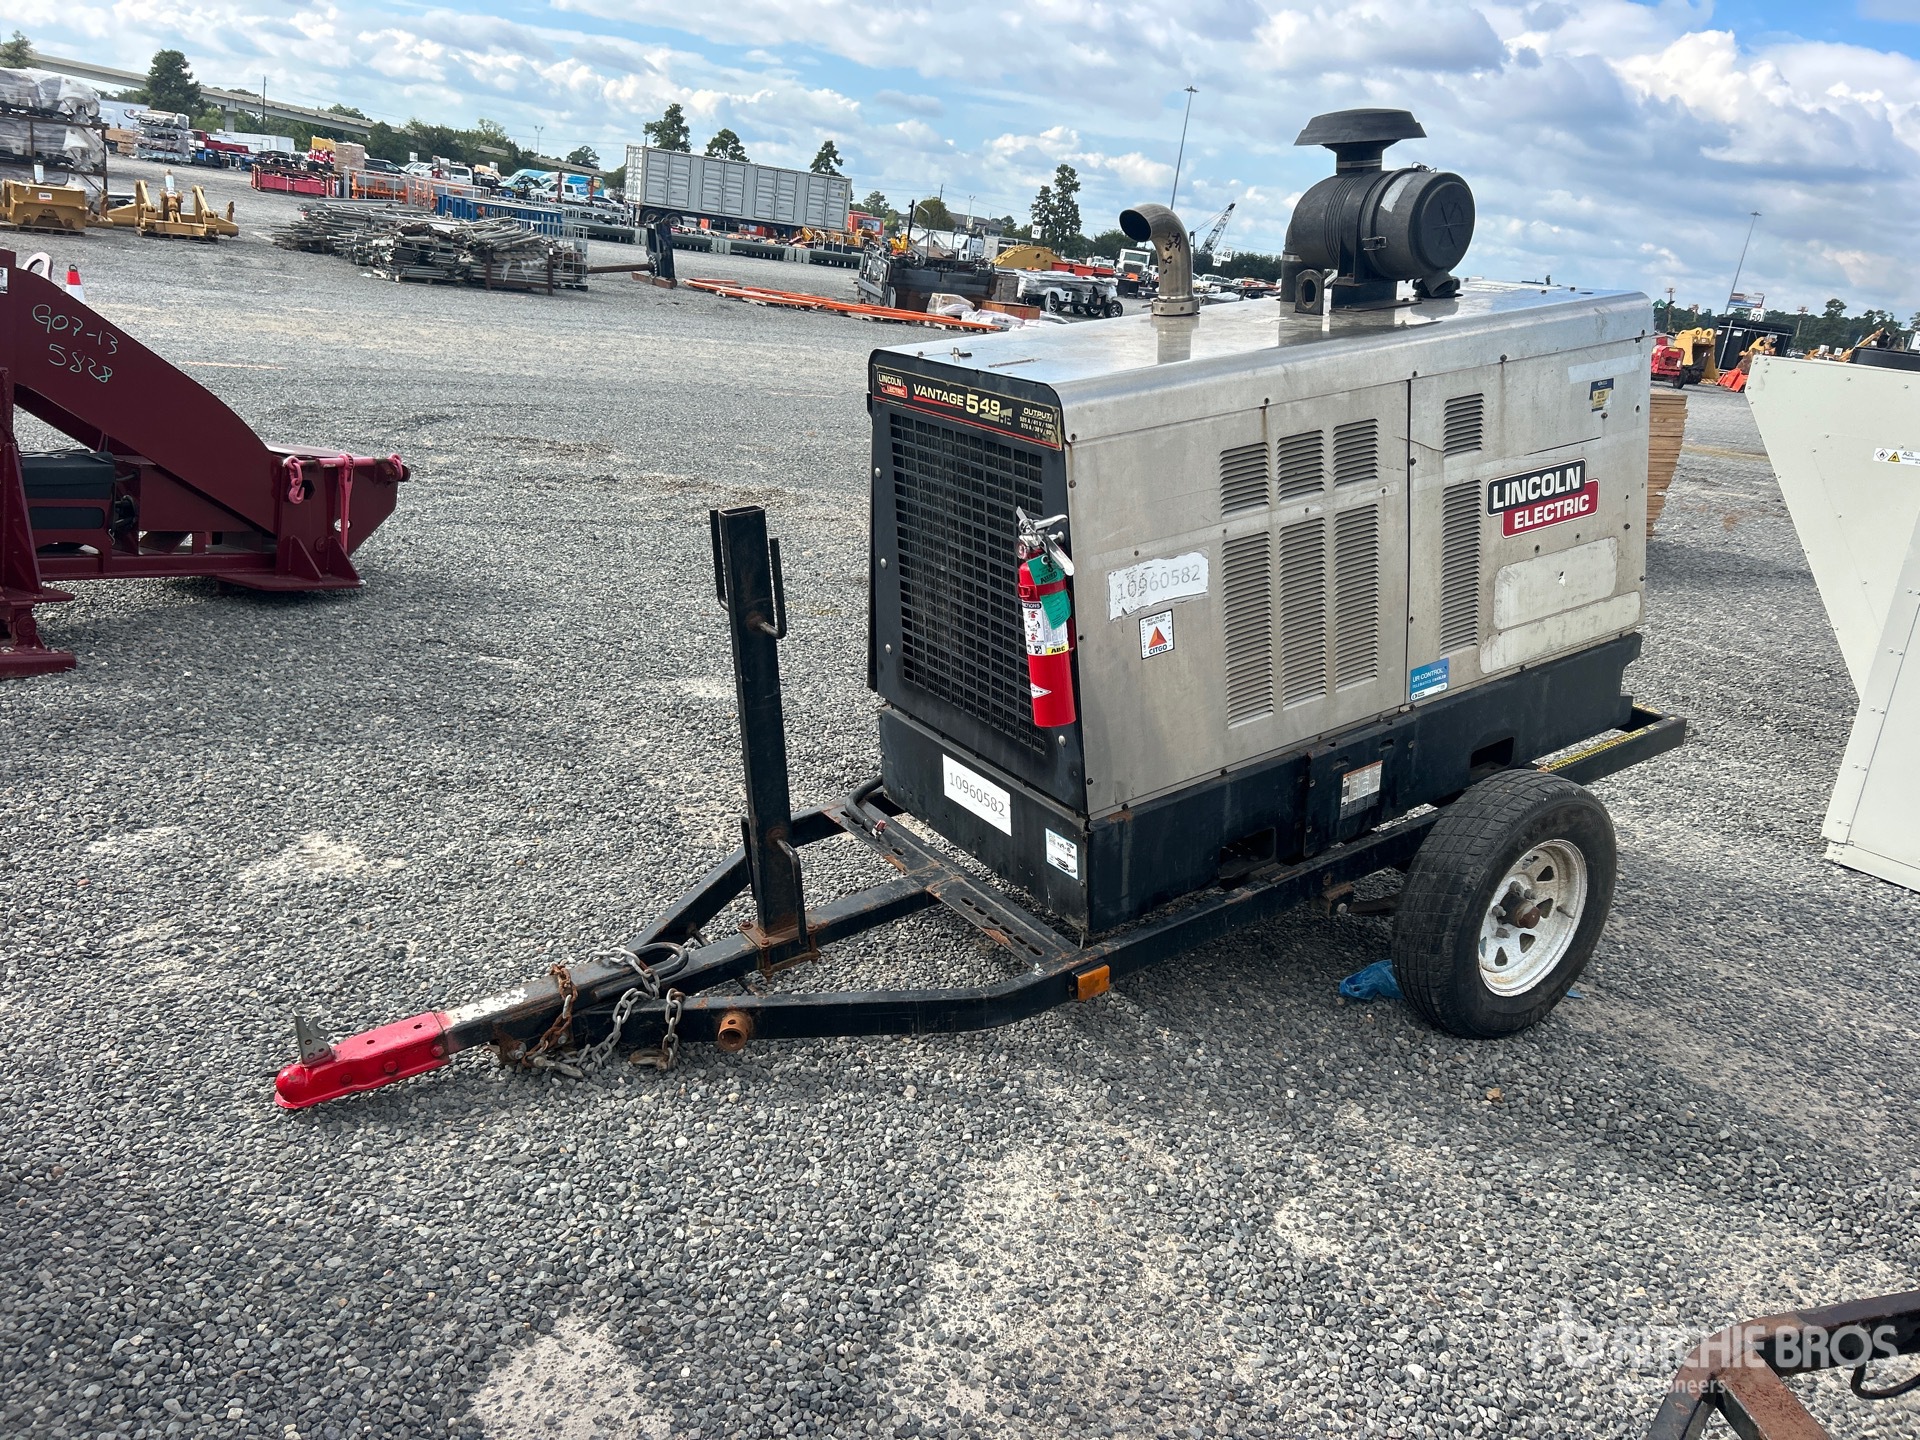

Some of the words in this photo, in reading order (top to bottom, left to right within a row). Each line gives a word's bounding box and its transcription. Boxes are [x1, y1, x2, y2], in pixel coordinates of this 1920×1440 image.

[1222, 251, 1231, 259] 48
[1751, 313, 1762, 322] 50
[48, 343, 113, 383] 5828
[878, 373, 902, 387] LINCOLN
[883, 385, 905, 396] LECTRIC
[913, 383, 964, 407] VANTAGE
[965, 393, 1001, 415] 549
[1492, 465, 1582, 509] LINCOLN
[1514, 494, 1590, 530] ELECTRIC
[1116, 564, 1201, 600] 10960582
[1050, 646, 1066, 654] ABC
[1148, 644, 1168, 655] CITGO
[1420, 668, 1444, 680] CONTROL
[949, 772, 1006, 817] 10960582
